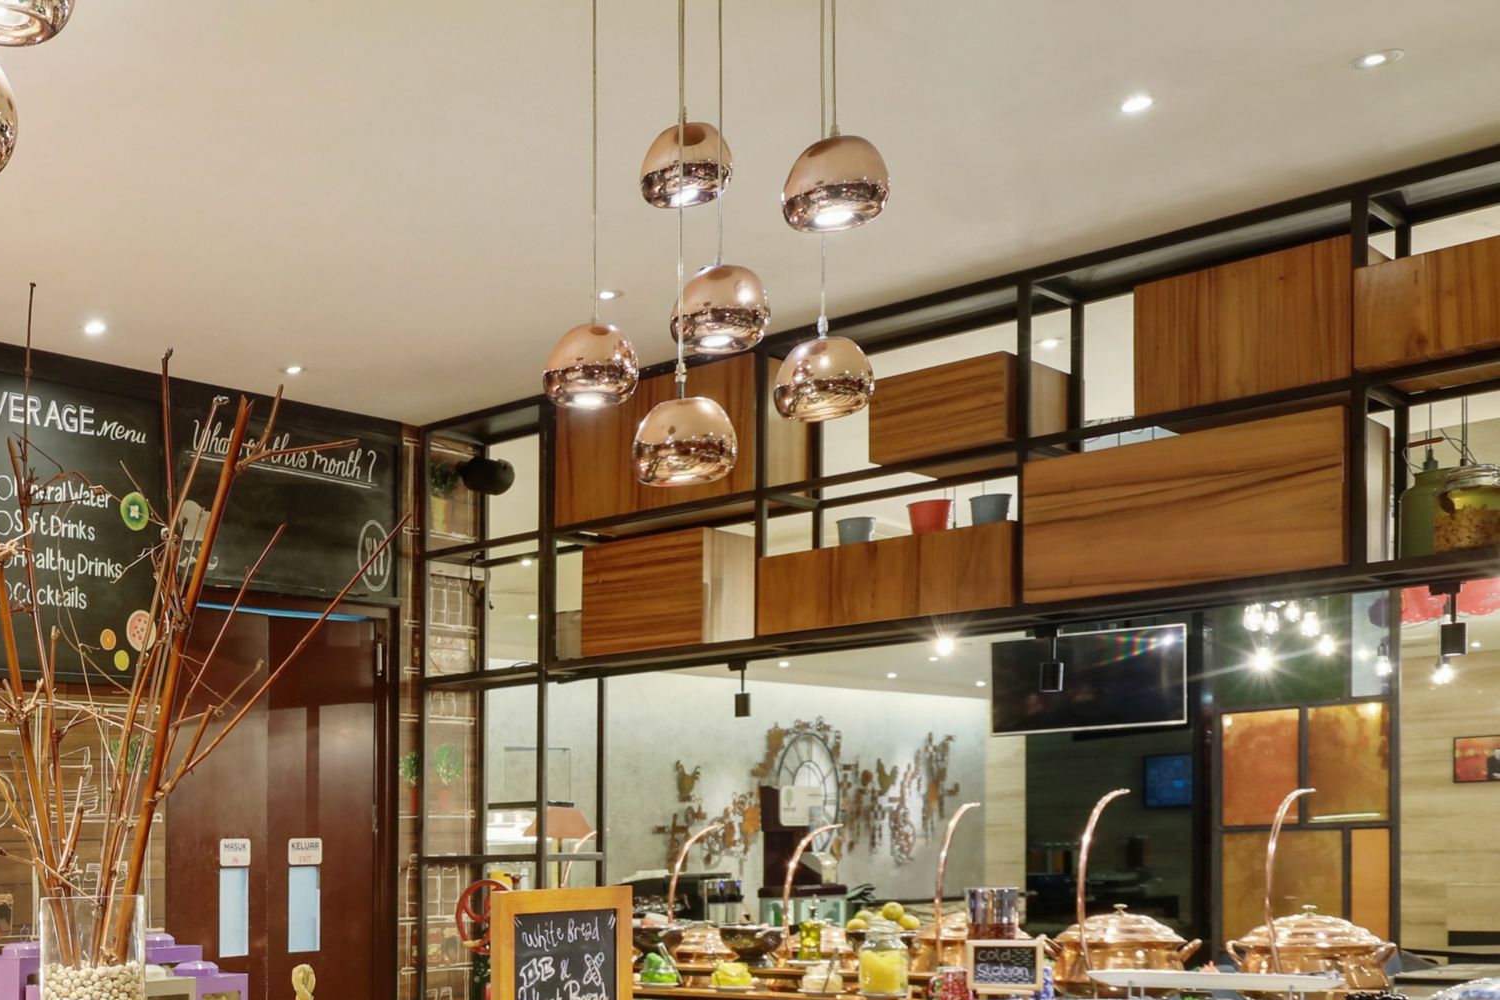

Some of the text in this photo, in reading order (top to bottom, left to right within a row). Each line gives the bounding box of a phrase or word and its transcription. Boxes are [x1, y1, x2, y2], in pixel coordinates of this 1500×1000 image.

[96, 419, 148, 445] Menu
[311, 448, 363, 480] month
[67, 480, 112, 509] Water
[50, 514, 96, 542] Drinks
[77, 553, 124, 579] Drinks
[291, 841, 320, 851] KELUAR
